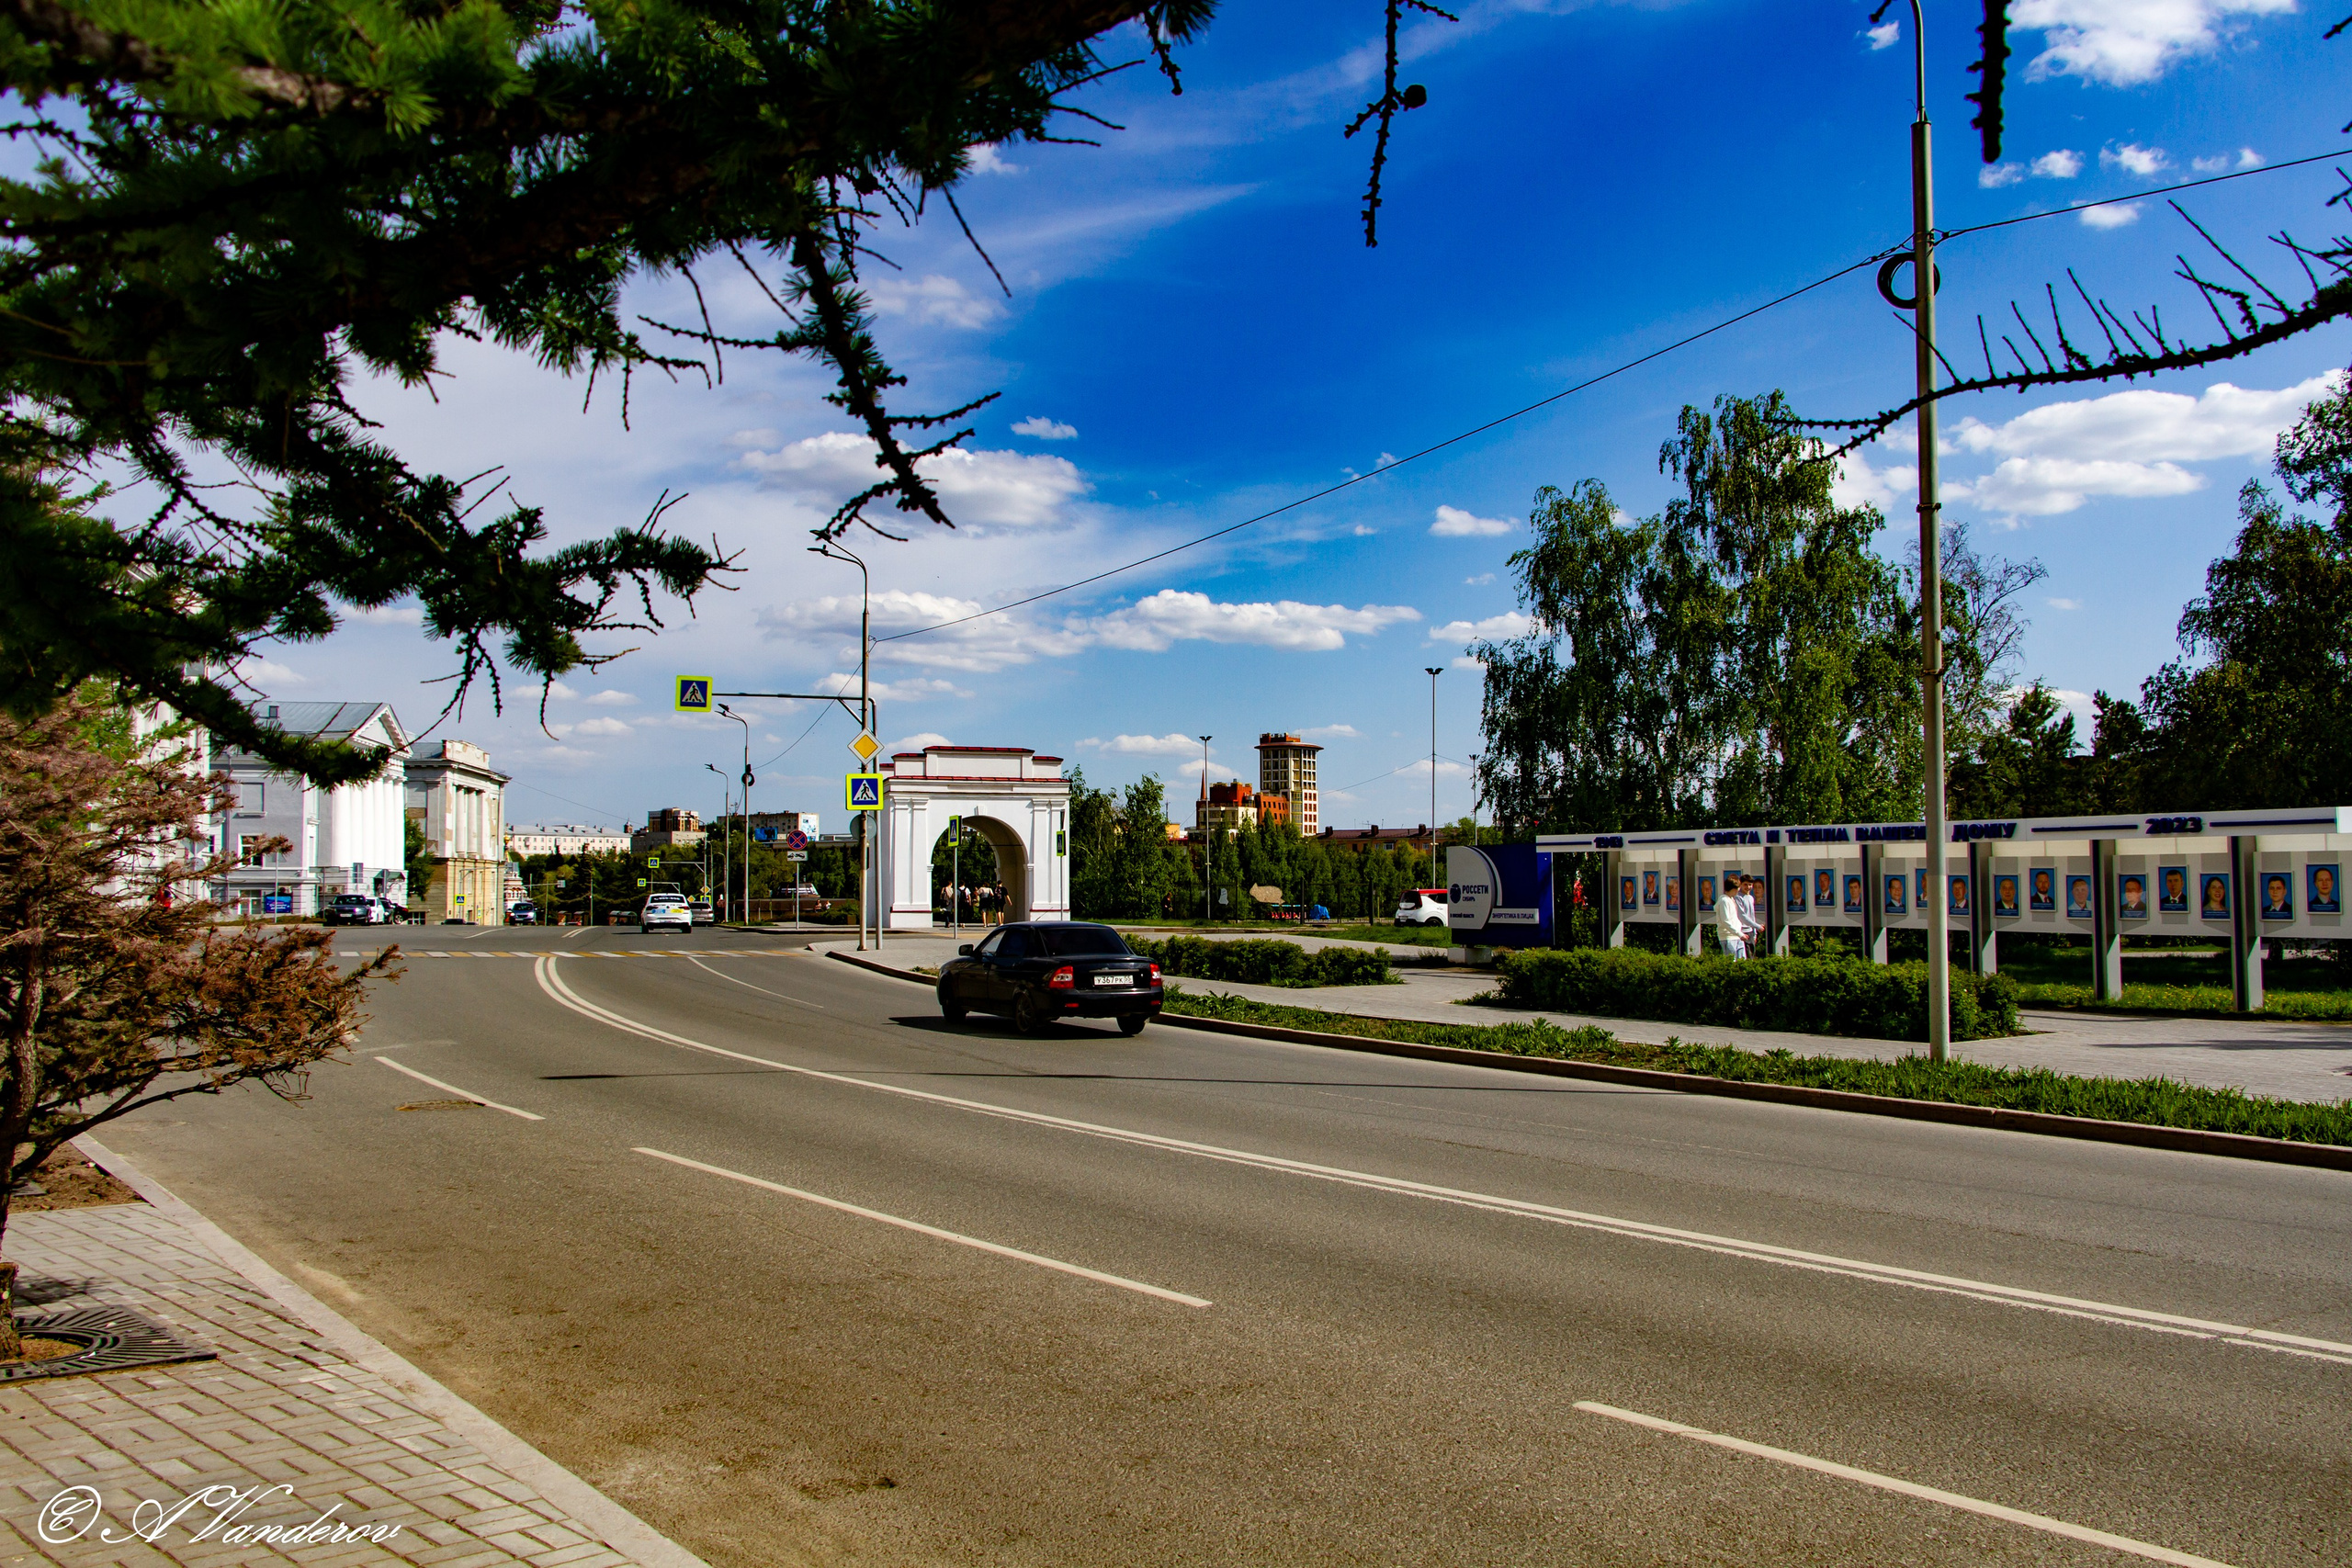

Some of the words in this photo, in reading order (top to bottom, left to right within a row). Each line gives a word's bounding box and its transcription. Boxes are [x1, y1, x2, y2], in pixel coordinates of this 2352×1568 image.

[1703, 830, 1760, 845] СВЕТА
[1766, 830, 1779, 843] И
[1786, 828, 1849, 842] ТЕПЛА
[1951, 823, 2017, 842] ДОМУ
[2145, 817, 2202, 834] 2023
[1462, 885, 1488, 894] РОССЕТИ
